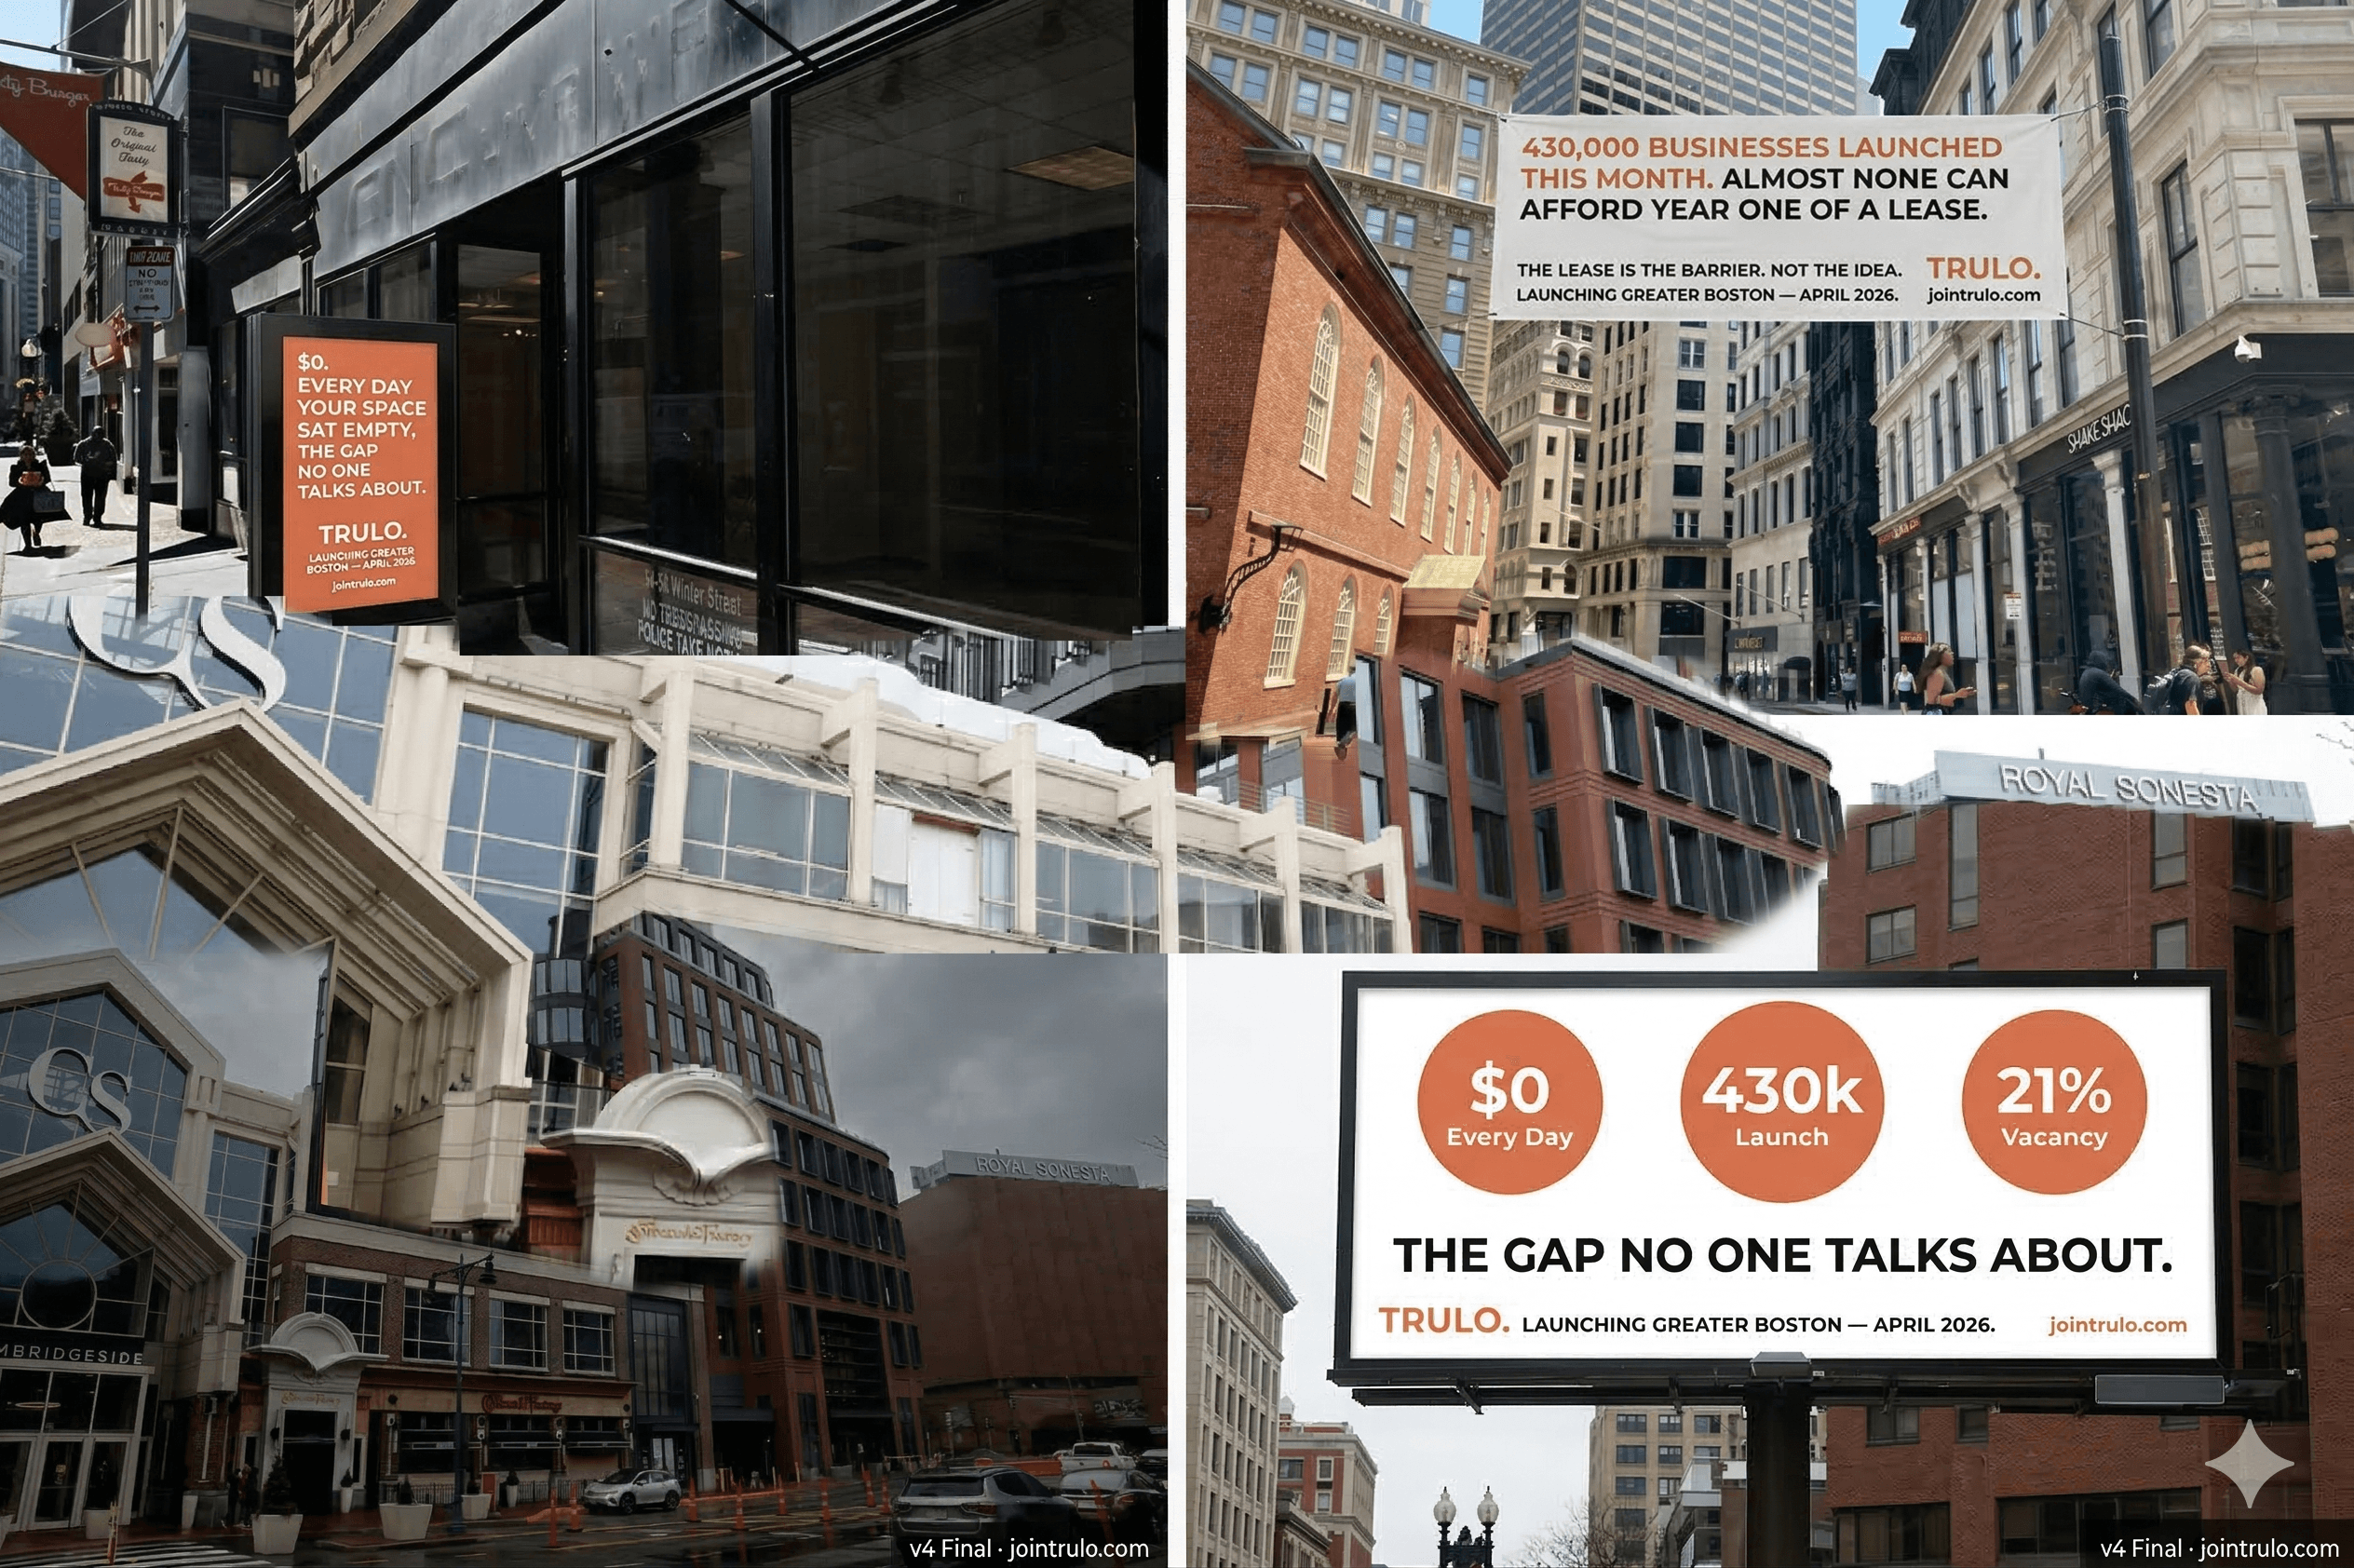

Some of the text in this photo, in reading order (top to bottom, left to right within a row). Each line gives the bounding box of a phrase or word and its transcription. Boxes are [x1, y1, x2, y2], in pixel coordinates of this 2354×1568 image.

[1522, 136, 2003, 162] 430,000 BUSINESSES LAUNCHED
[1520, 168, 2009, 190] THIS MONTH. ALMOST NONE CAN
[1519, 198, 1988, 221] AFFORD YEAR ONE OF A LEASE.
[139, 269, 156, 277] NO
[1516, 263, 1903, 277] THE LEASE IS THE BARRIER. NOT THE IDEA.
[1926, 256, 2041, 280] TRULO.
[1517, 288, 1617, 302] LAUNCHING
[1621, 288, 1700, 302] GREATER
[1704, 288, 1775, 302] BOSTON
[1798, 288, 1850, 302] APRIL
[1853, 288, 1900, 302] 2026.
[1926, 287, 2041, 305] jointrulo.com
[298, 352, 329, 372] $0.
[298, 377, 413, 394] EVERY DAY
[297, 399, 426, 415] YOUR SPACE
[297, 423, 416, 439] SAT EMPTY,
[2068, 404, 2131, 453] SHAKE SHAC
[298, 444, 378, 458] THE GAP
[298, 463, 371, 479] NO ONE
[298, 480, 426, 499] TALKS ABOUT.
[318, 521, 408, 544] TRULO.
[371, 547, 414, 557] GREATER
[307, 562, 348, 574] BOSTON
[362, 559, 392, 569] APRIL
[331, 577, 396, 593] jointrulo.com
[671, 574, 705, 605] Winter
[638, 619, 673, 651] POLICE
[676, 632, 703, 656] TAKE
[1998, 764, 2260, 812] ROYAL SONESTA
[1468, 1060, 1551, 1120] $0
[1702, 1064, 1864, 1115] 430k
[1996, 1065, 2112, 1114] 21%
[1447, 1128, 1574, 1151] Every Day
[1736, 1127, 1829, 1146] Launch
[2001, 1128, 2109, 1152] Vacancy
[976, 1156, 1112, 1183] ROYAL SONESTA
[1392, 1237, 2172, 1274] THE GAP NO ONE TALKS ABOUT.
[1378, 1306, 1510, 1333] TRULO.
[1522, 1317, 1646, 1333] LAUNCHING
[1652, 1317, 1749, 1333] GREATER
[1755, 1317, 1842, 1333] BOSTON
[1873, 1317, 1936, 1332] APRIL
[1941, 1317, 1995, 1333] 2026.
[2048, 1316, 2187, 1337] jointrulo.com
